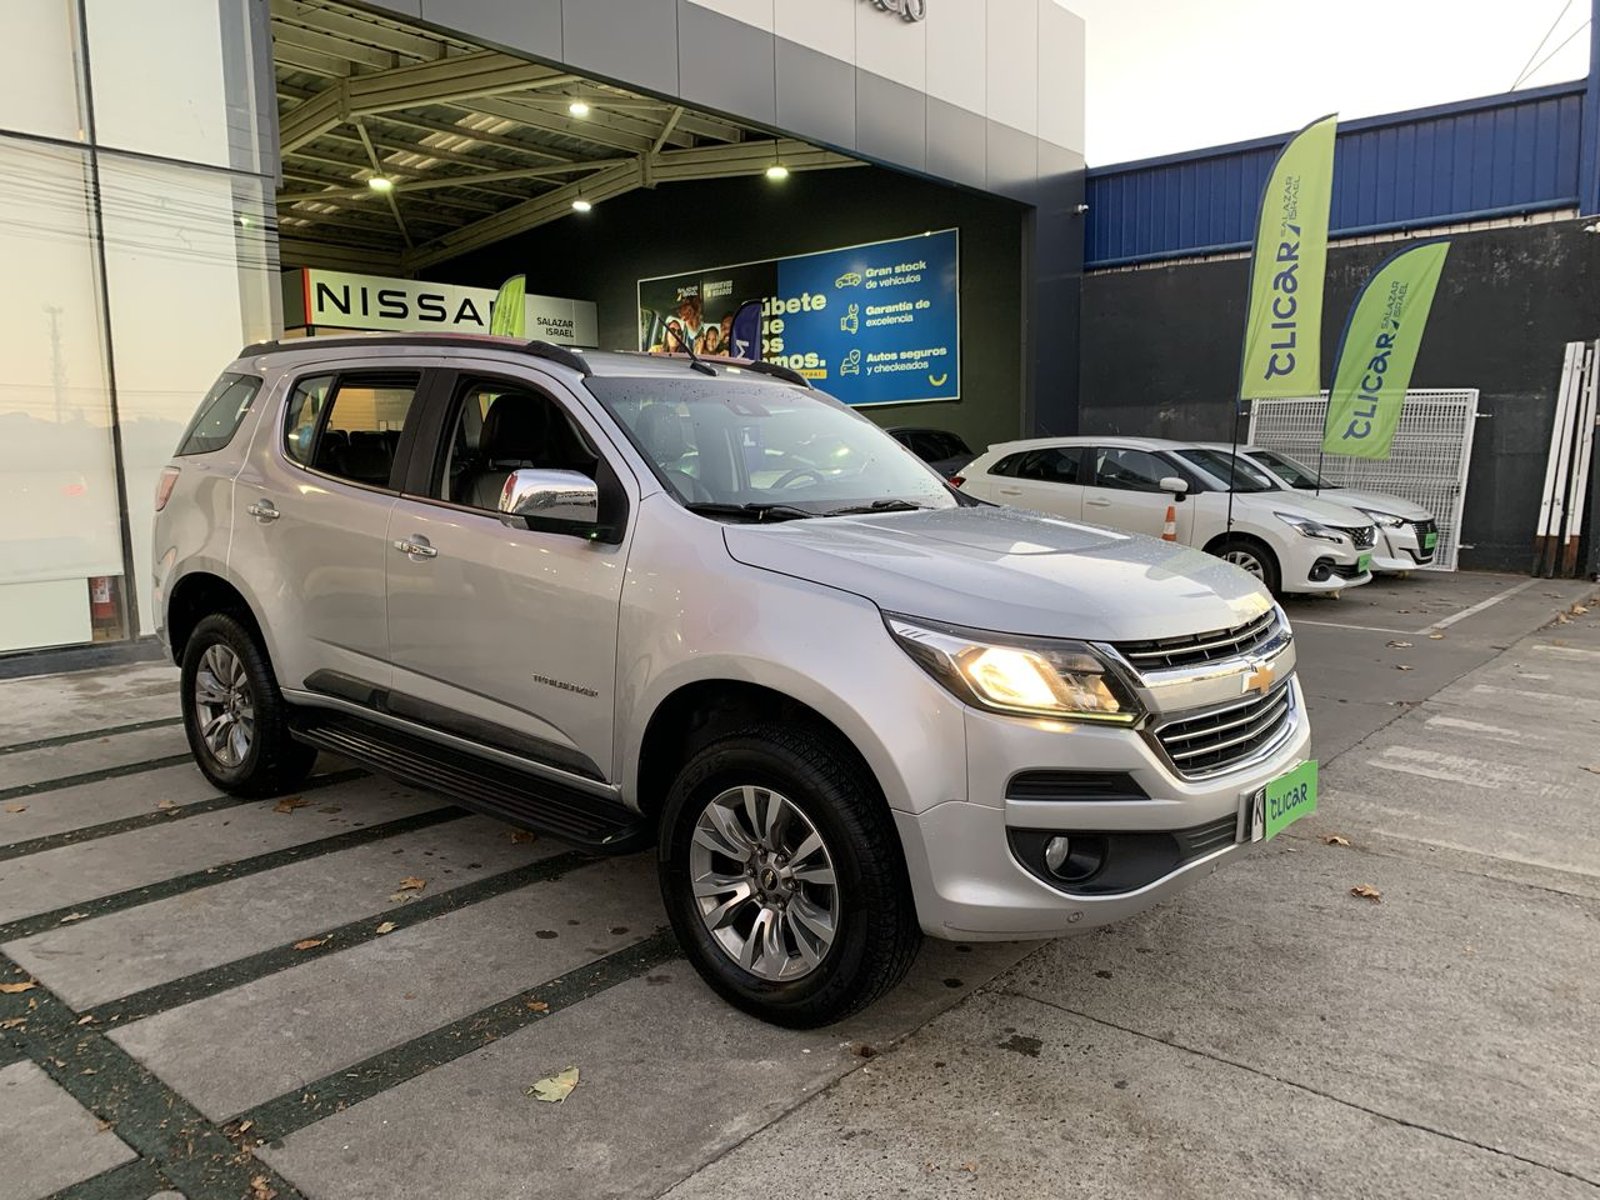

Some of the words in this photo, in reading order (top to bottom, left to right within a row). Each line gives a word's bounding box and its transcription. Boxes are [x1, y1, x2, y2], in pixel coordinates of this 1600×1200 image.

[1288, 175, 1300, 220] ISRAEL
[1280, 176, 1293, 237] SALAZAR
[865, 267, 892, 278] Gran
[894, 260, 927, 274] stock
[865, 280, 877, 290] de
[879, 274, 921, 288] vehículos
[761, 292, 827, 317] úbete
[865, 301, 913, 316] Garantía
[915, 299, 931, 310] de
[1380, 280, 1400, 330] SALAZAR
[1393, 282, 1408, 318] ISRAEL
[536, 317, 574, 329] SALAZAR
[865, 313, 914, 327] excelencia
[545, 327, 574, 338] ISRAEL
[762, 352, 827, 370] mos.
[866, 352, 898, 363] Autos
[899, 347, 947, 360] seguros
[866, 366, 872, 375] y
[873, 361, 929, 374] checkeados
